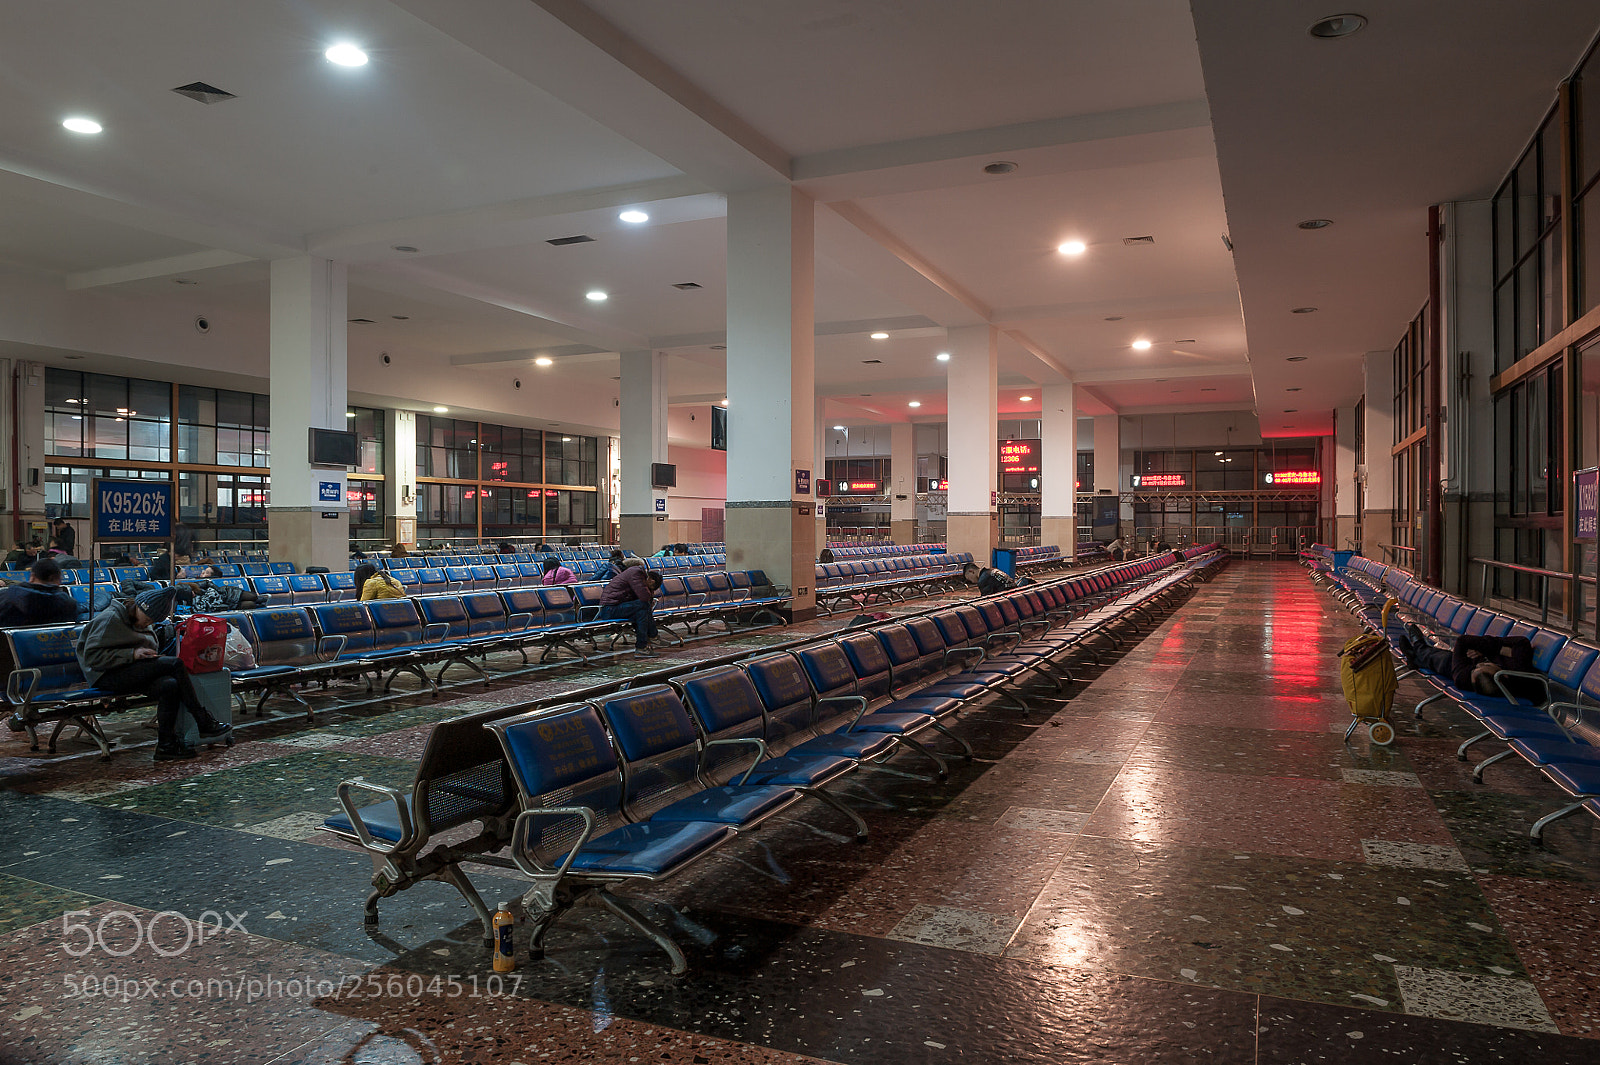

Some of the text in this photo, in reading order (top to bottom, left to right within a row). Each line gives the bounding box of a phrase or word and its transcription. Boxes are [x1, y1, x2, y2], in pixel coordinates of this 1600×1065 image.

[1133, 475, 1141, 487] 7
[1265, 473, 1274, 484] 6
[838, 481, 849, 492] 10
[931, 480, 938, 490] 9
[101, 490, 166, 517] K9526次
[108, 518, 160, 533] 在此候车
